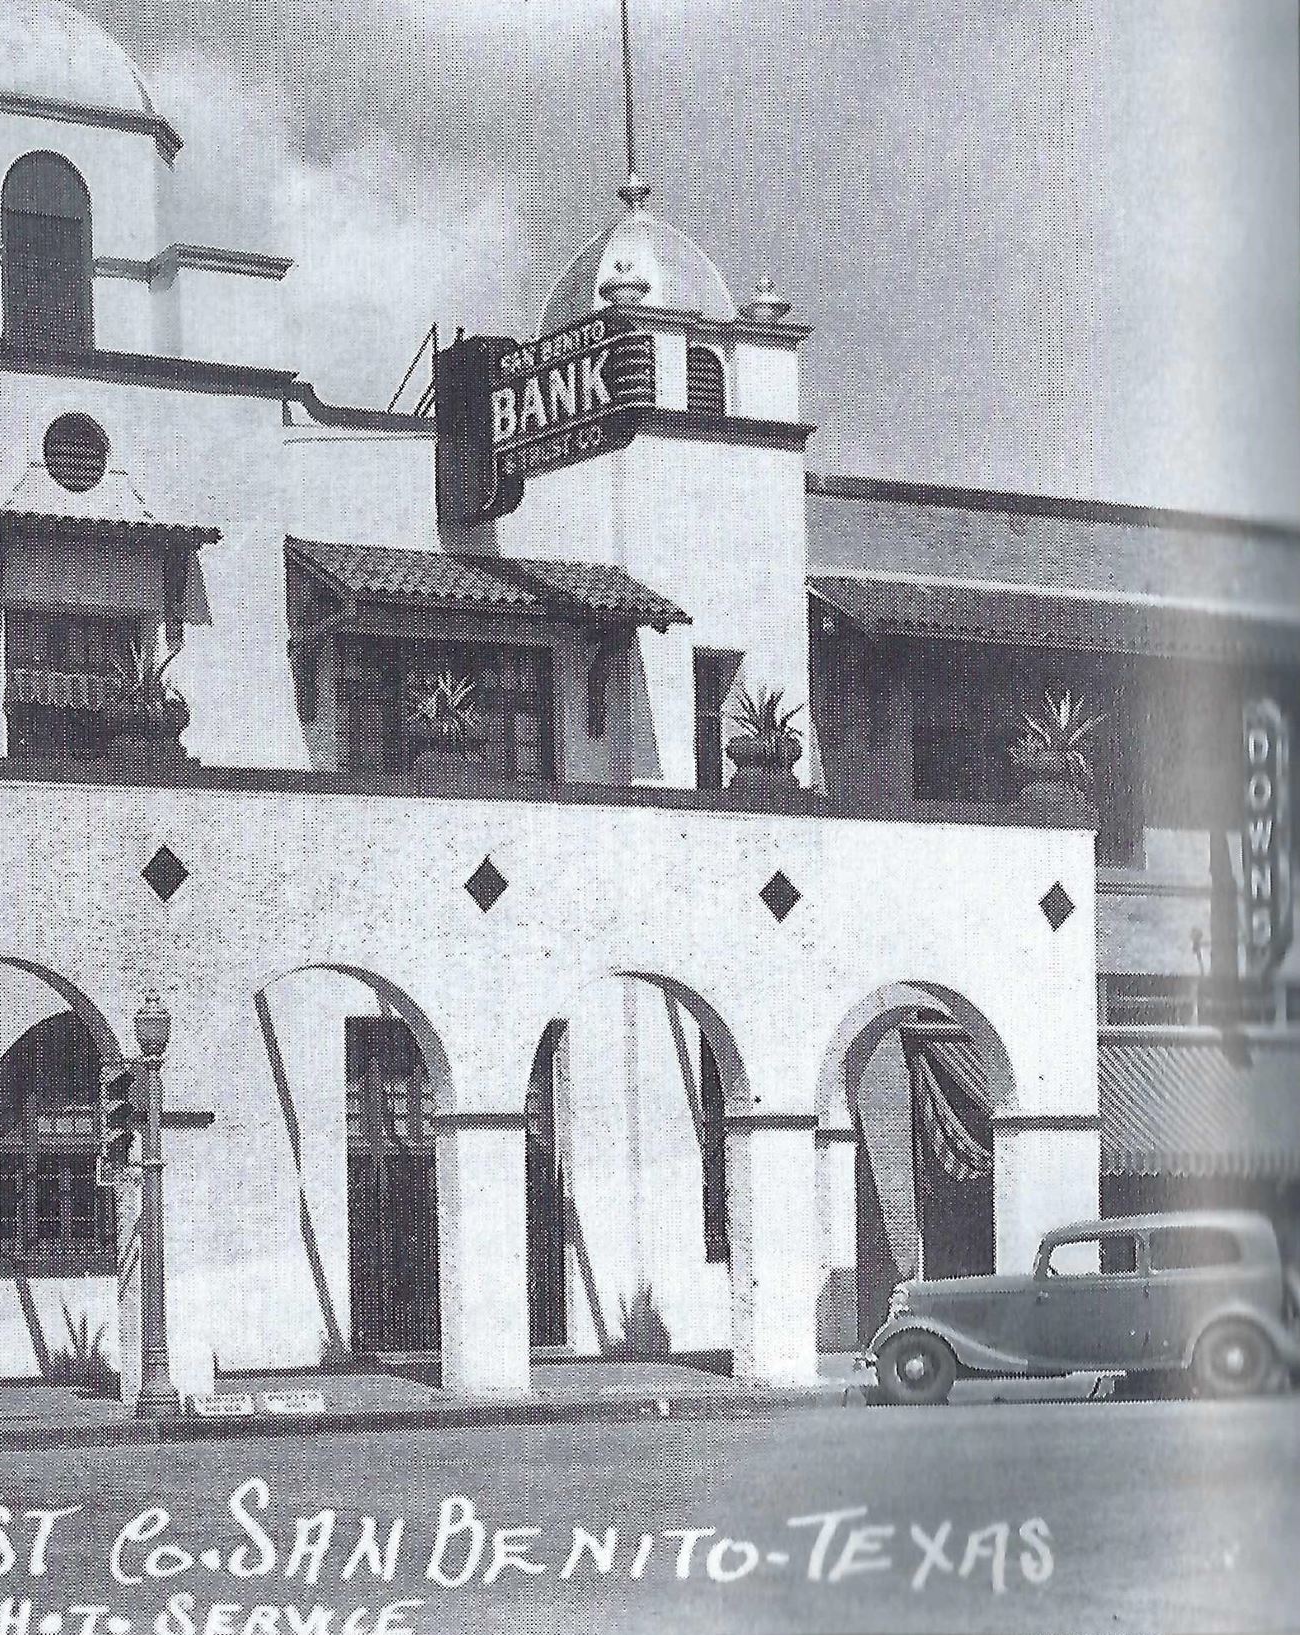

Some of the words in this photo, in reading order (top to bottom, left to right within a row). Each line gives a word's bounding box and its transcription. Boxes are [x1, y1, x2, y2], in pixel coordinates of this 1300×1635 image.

[500, 346, 536, 373] SAN
[541, 319, 606, 362] BENITO
[490, 349, 612, 444] BANK
[519, 432, 572, 470] TRUST
